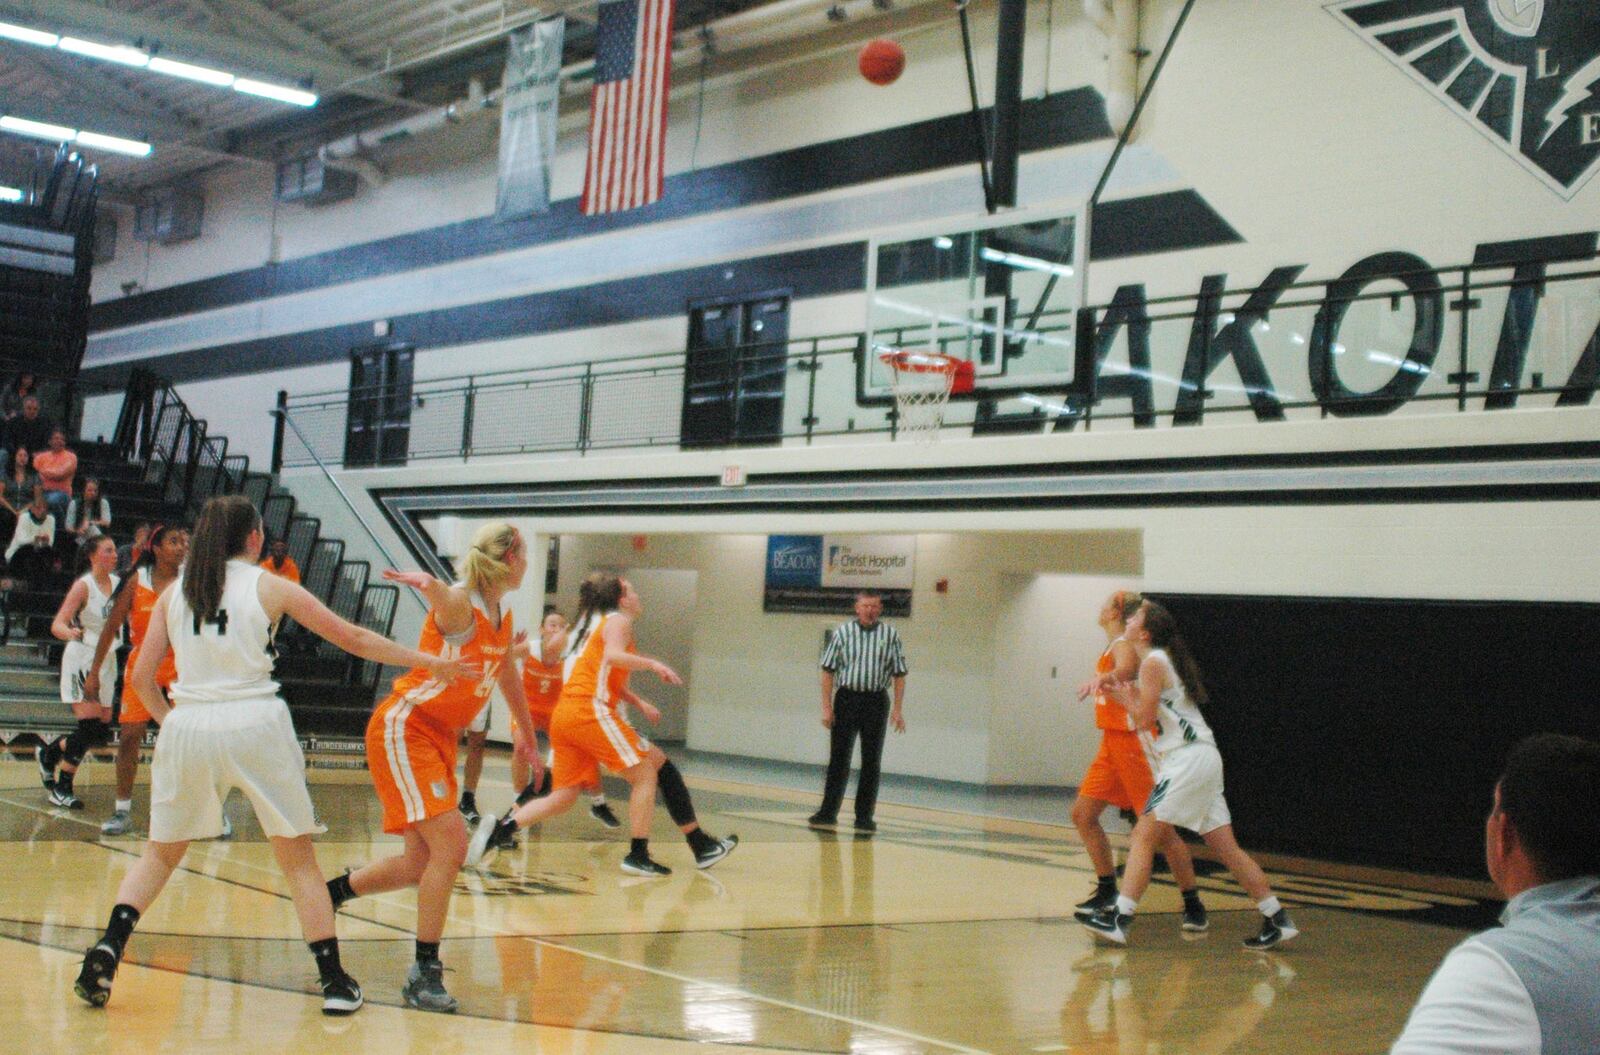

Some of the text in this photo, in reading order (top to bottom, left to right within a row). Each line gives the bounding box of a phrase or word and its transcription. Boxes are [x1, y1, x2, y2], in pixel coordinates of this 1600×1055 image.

[1536, 47, 1560, 79] L
[773, 550, 817, 569] BEACON
[841, 554, 906, 569] Christ Hospital
